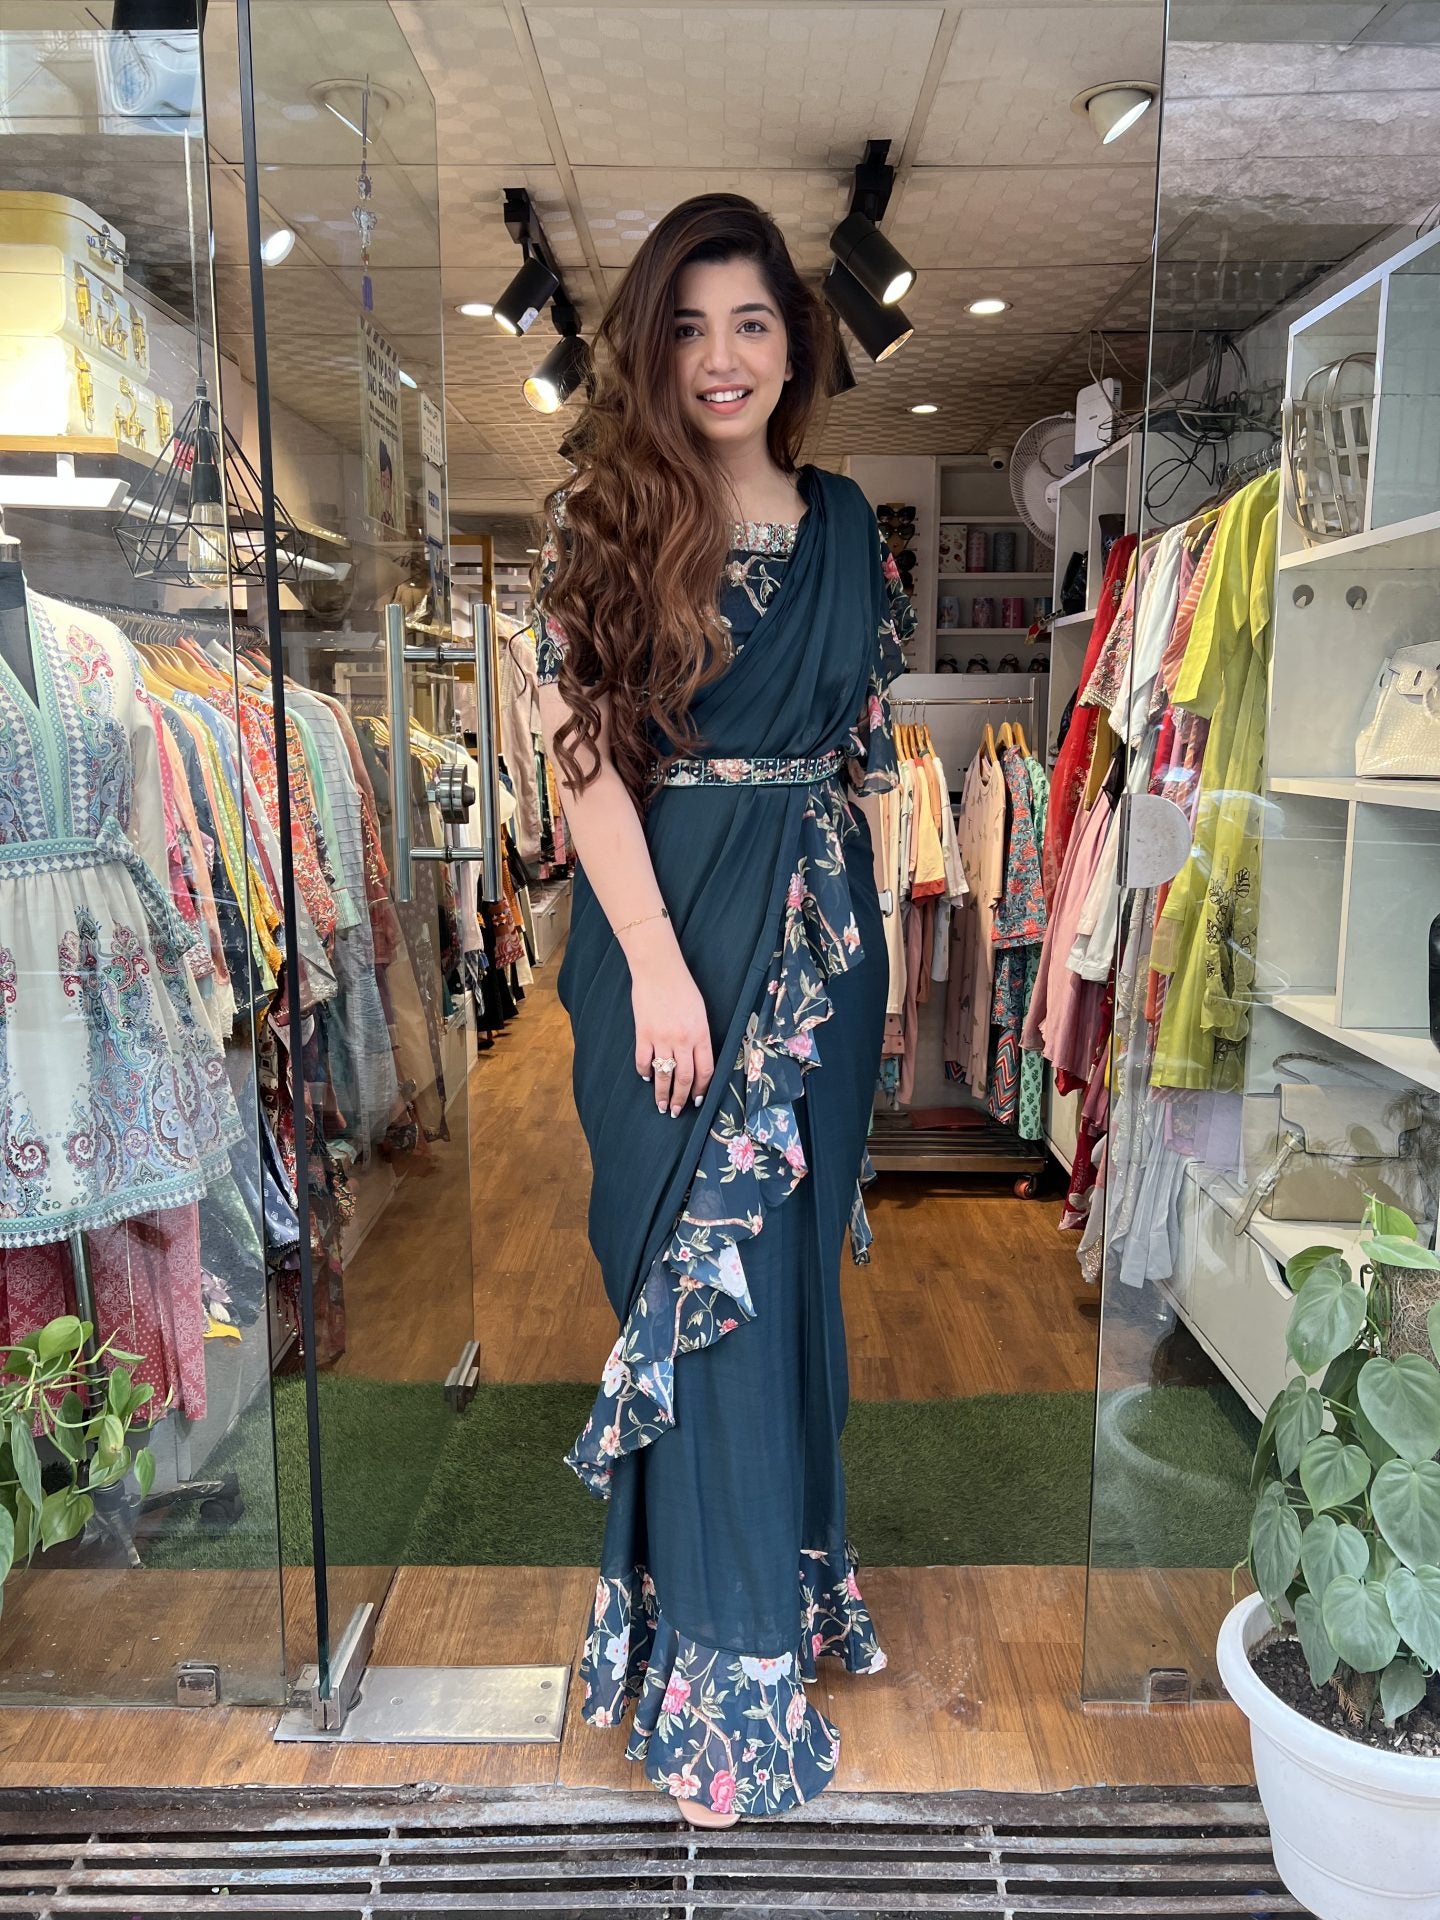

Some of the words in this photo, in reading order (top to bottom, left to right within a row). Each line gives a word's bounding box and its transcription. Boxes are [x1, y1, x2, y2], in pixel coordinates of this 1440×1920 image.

[366, 343, 377, 370] NO
[367, 371, 377, 396] NO
[378, 381, 397, 415] ENTRY
